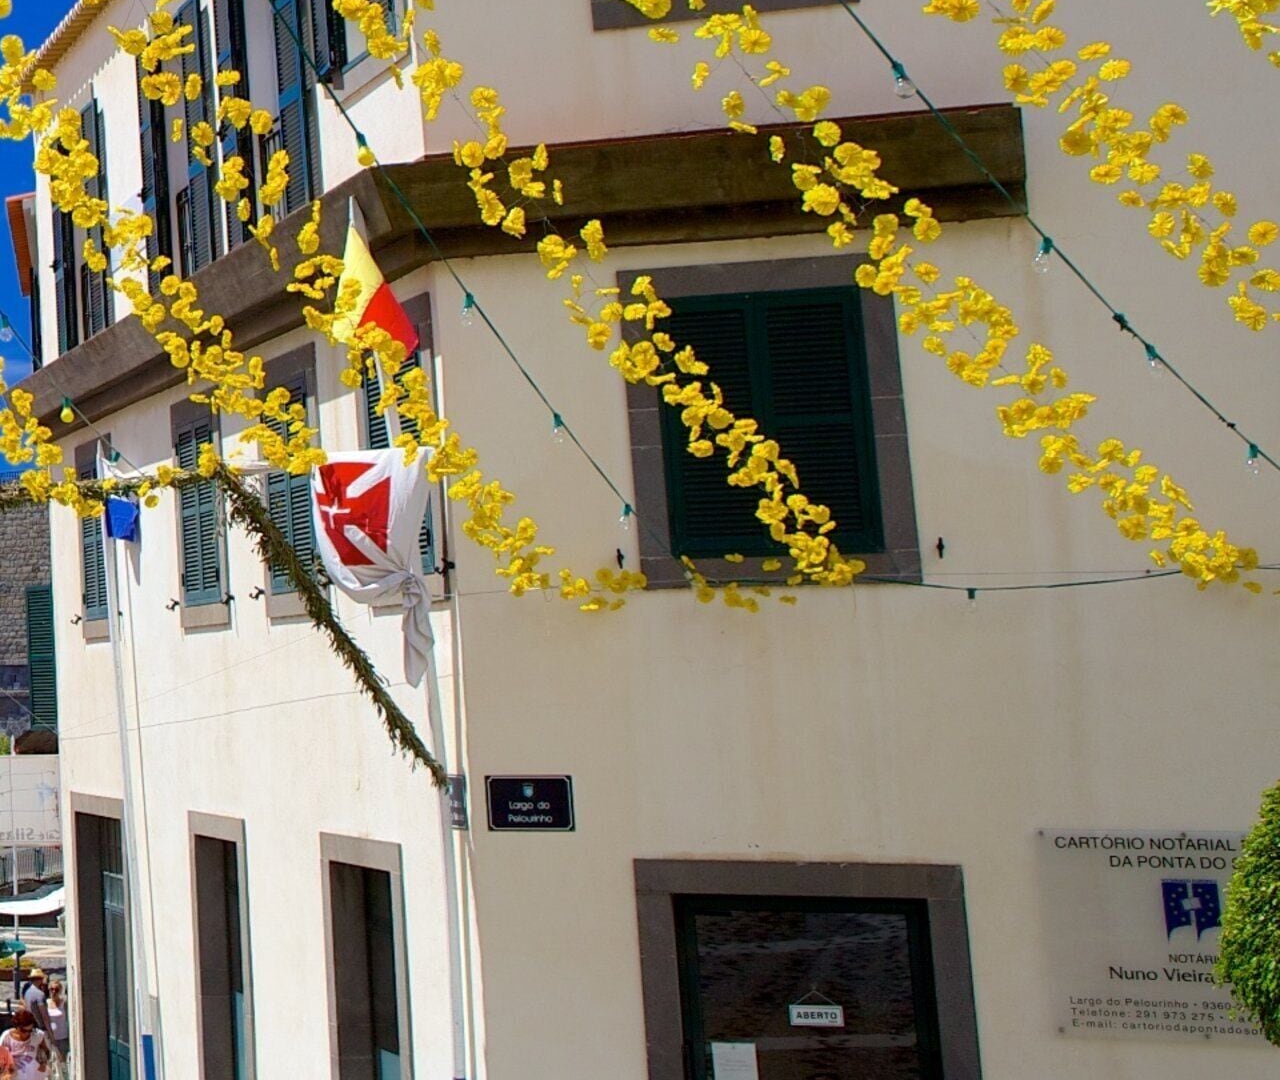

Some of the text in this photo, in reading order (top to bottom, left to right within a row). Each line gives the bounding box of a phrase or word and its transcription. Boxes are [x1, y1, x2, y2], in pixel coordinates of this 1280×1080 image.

[508, 801, 551, 811] Largo do
[507, 814, 553, 823] Pelourinho
[1054, 834, 1145, 850] CARTÓRIO
[1149, 838, 1237, 851] NOTARIAL
[1109, 855, 1133, 868] DA
[1137, 855, 1196, 869] PONTA
[1199, 856, 1227, 870] DO
[1168, 953, 1219, 964] NOTÁRI
[1109, 966, 1158, 981] Nuno
[1162, 967, 1216, 984] Vieira
[1069, 996, 1102, 1007] Largo
[1106, 998, 1121, 1006] do
[1124, 998, 1189, 1008] Pelourinho
[796, 1011, 838, 1020] ABERTO
[1135, 1010, 1157, 1018] 291
[1163, 1011, 1186, 1020] 973
[1191, 1013, 1215, 1021] 275
